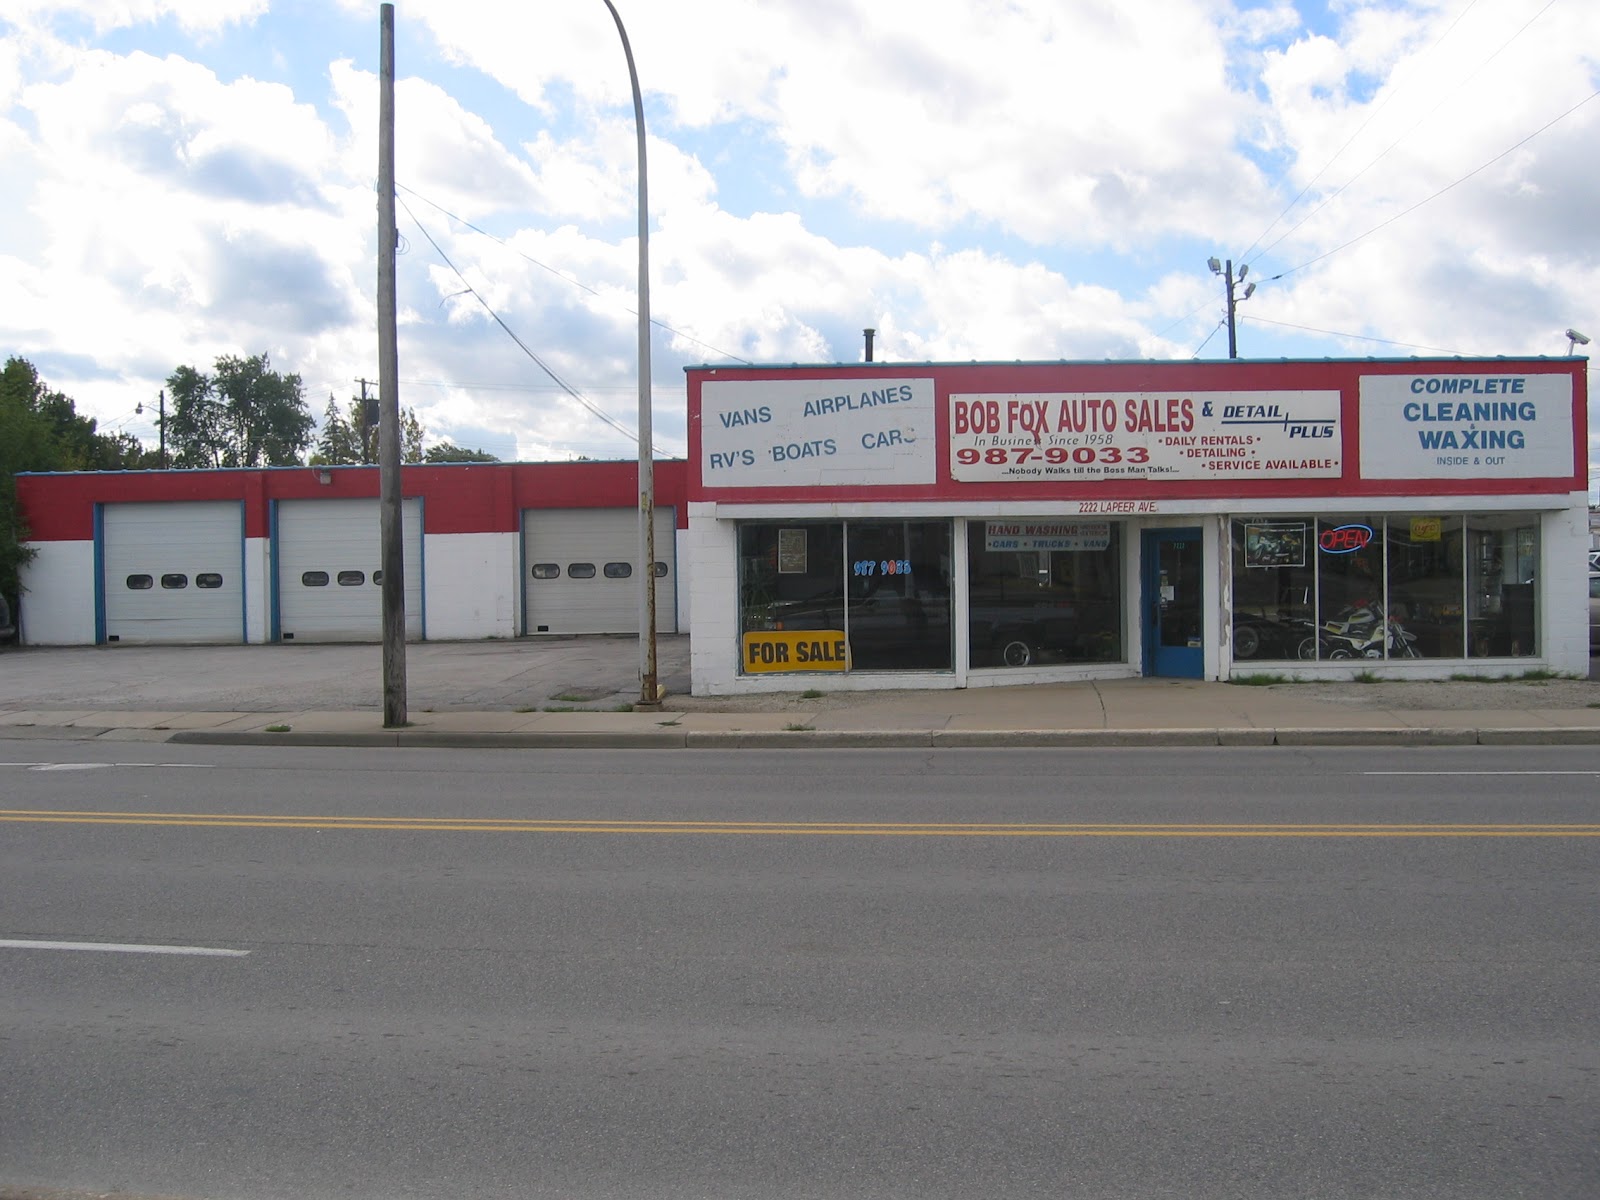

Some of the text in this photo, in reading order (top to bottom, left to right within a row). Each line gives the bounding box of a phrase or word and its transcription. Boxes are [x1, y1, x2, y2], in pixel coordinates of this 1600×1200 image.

[1410, 378, 1525, 394] COMPLETE
[719, 385, 913, 428] VANS AIRPLANES
[1223, 405, 1282, 418] DETAIL
[1403, 402, 1536, 421] CLEANING
[954, 398, 1214, 434] BOB FOX AUTO SALES &
[1289, 425, 1334, 439] PLUS
[974, 435, 986, 446] In
[1049, 434, 1079, 445] Since
[1085, 434, 1114, 446] 1958
[1165, 435, 1253, 446] DAILY RENTALS
[1418, 430, 1525, 449] WAXING
[709, 449, 756, 470] RV'S
[772, 438, 837, 462] BOATS
[956, 447, 1150, 465] 987-9033
[1187, 448, 1246, 458] DETAILING
[1208, 460, 1331, 470] SERVICE AVAILABLE
[1436, 457, 1505, 465] INSIDE & OUT
[1045, 467, 1070, 475] Walks
[1073, 466, 1085, 474] till
[1087, 466, 1101, 474] the
[1104, 466, 1125, 474] Boss
[1127, 466, 1146, 474] Man
[1079, 502, 1098, 513] 2222
[1101, 501, 1135, 513] LAPEER
[988, 525, 1020, 535] HAND
[1025, 525, 1078, 535] WASHING
[992, 540, 1107, 548] CARS TRUCKS VANS
[1320, 530, 1369, 549] OPEN
[750, 641, 846, 664] FOR SALE
